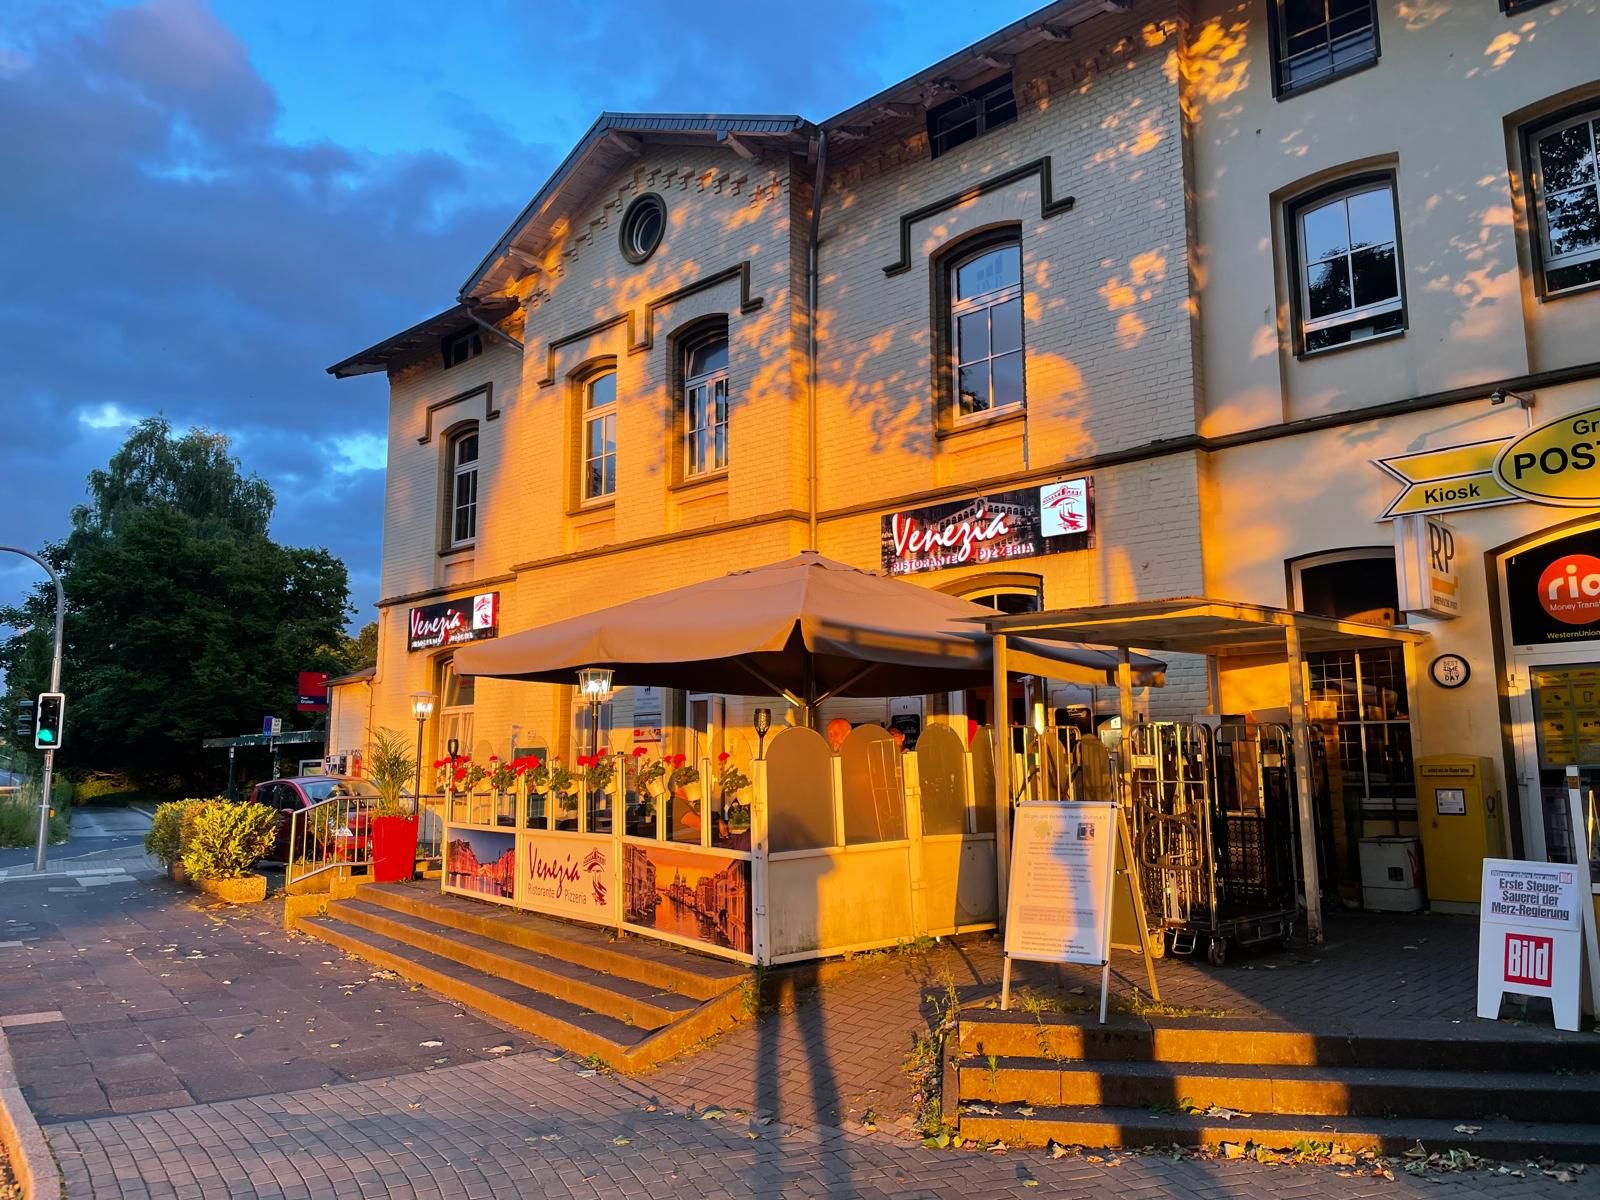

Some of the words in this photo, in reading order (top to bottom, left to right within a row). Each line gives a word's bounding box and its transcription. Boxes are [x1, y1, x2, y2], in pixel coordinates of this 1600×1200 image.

[1514, 440, 1600, 480] POS
[1424, 483, 1481, 504] Kiosk
[892, 510, 1009, 562] Venezia
[978, 542, 1035, 560] PIZZERIA
[1428, 522, 1455, 574] RP
[1550, 603, 1576, 612] Money
[411, 608, 462, 643] Venezia
[528, 841, 580, 899] Venezia
[528, 882, 555, 899] Ristorante
[564, 889, 587, 905] Pizzeria
[1499, 877, 1524, 891] Erste
[1526, 880, 1564, 894] Steuer-
[1502, 890, 1540, 905] Sauerei
[1542, 894, 1560, 906] der
[1491, 901, 1570, 920] Merz-Regierung
[1508, 938, 1549, 981] Bild
